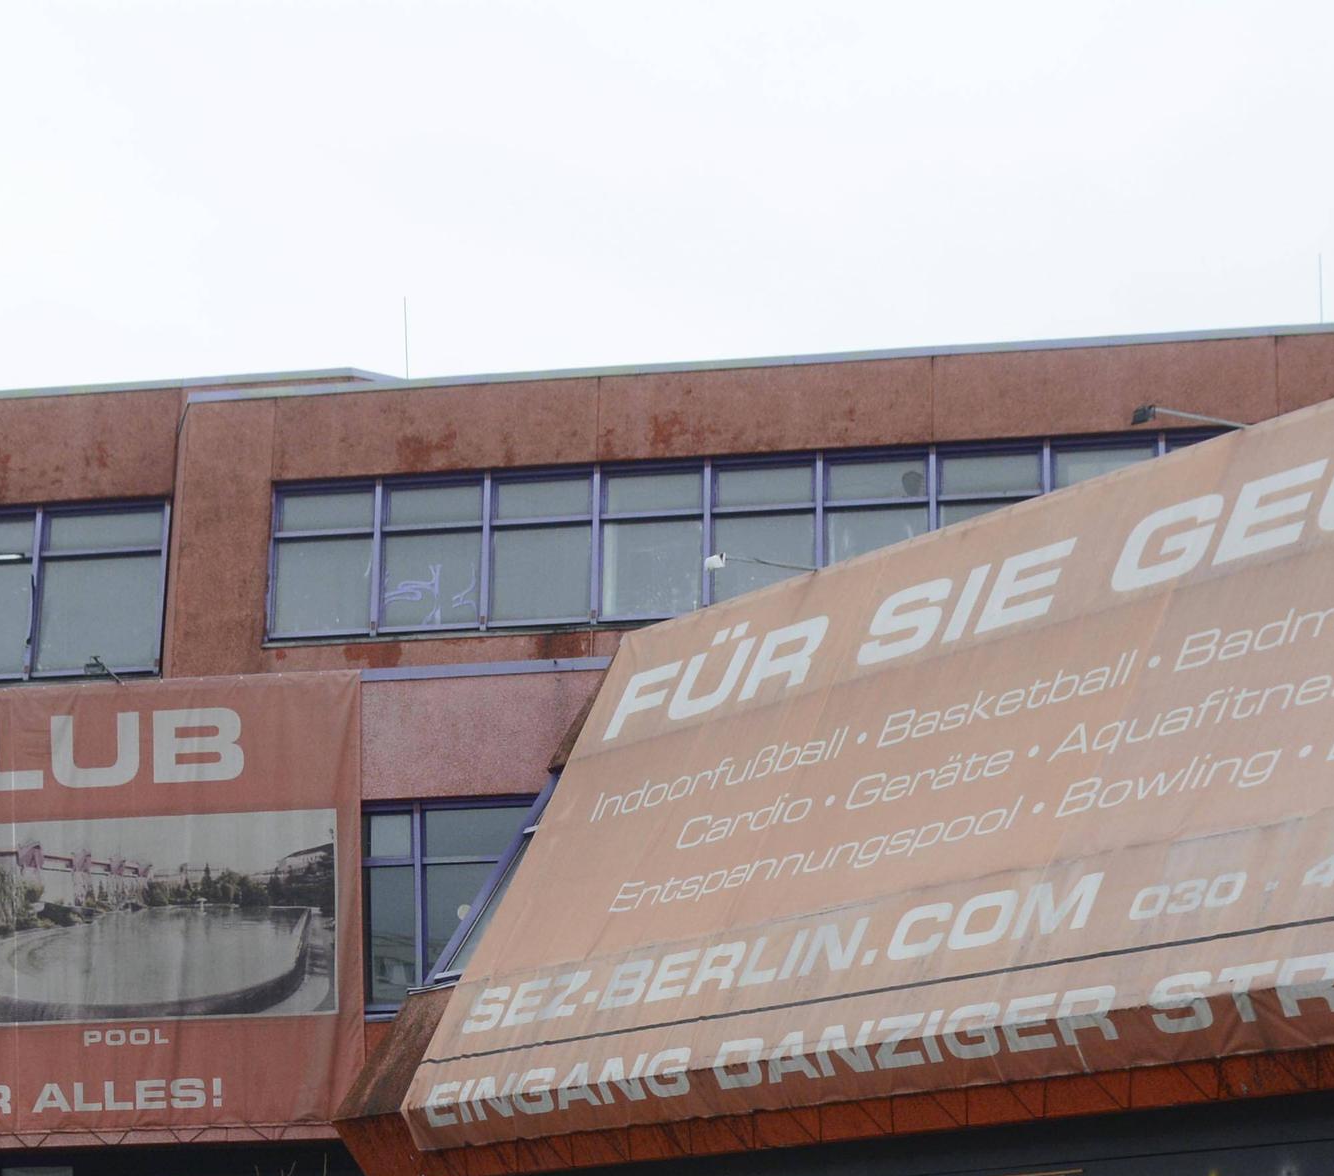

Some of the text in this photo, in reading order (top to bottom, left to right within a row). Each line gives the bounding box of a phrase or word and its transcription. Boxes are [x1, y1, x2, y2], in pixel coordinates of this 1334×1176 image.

[603, 613, 829, 741] FÜR
[857, 538, 1077, 665] SIE
[590, 725, 849, 822] Indoorfußball
[876, 650, 1139, 748] Basketball
[675, 792, 813, 850] Cardio
[846, 745, 1015, 810] Geräte
[608, 796, 1024, 913] Entspannungspool
[1054, 748, 1284, 818] Bowling
[1129, 871, 1245, 921] 030
[33, 1077, 224, 1112] ALLES!
[82, 1027, 169, 1047] POOL
[425, 1048, 693, 1128] EINGANG
[711, 985, 1120, 1090] DANZIGER
